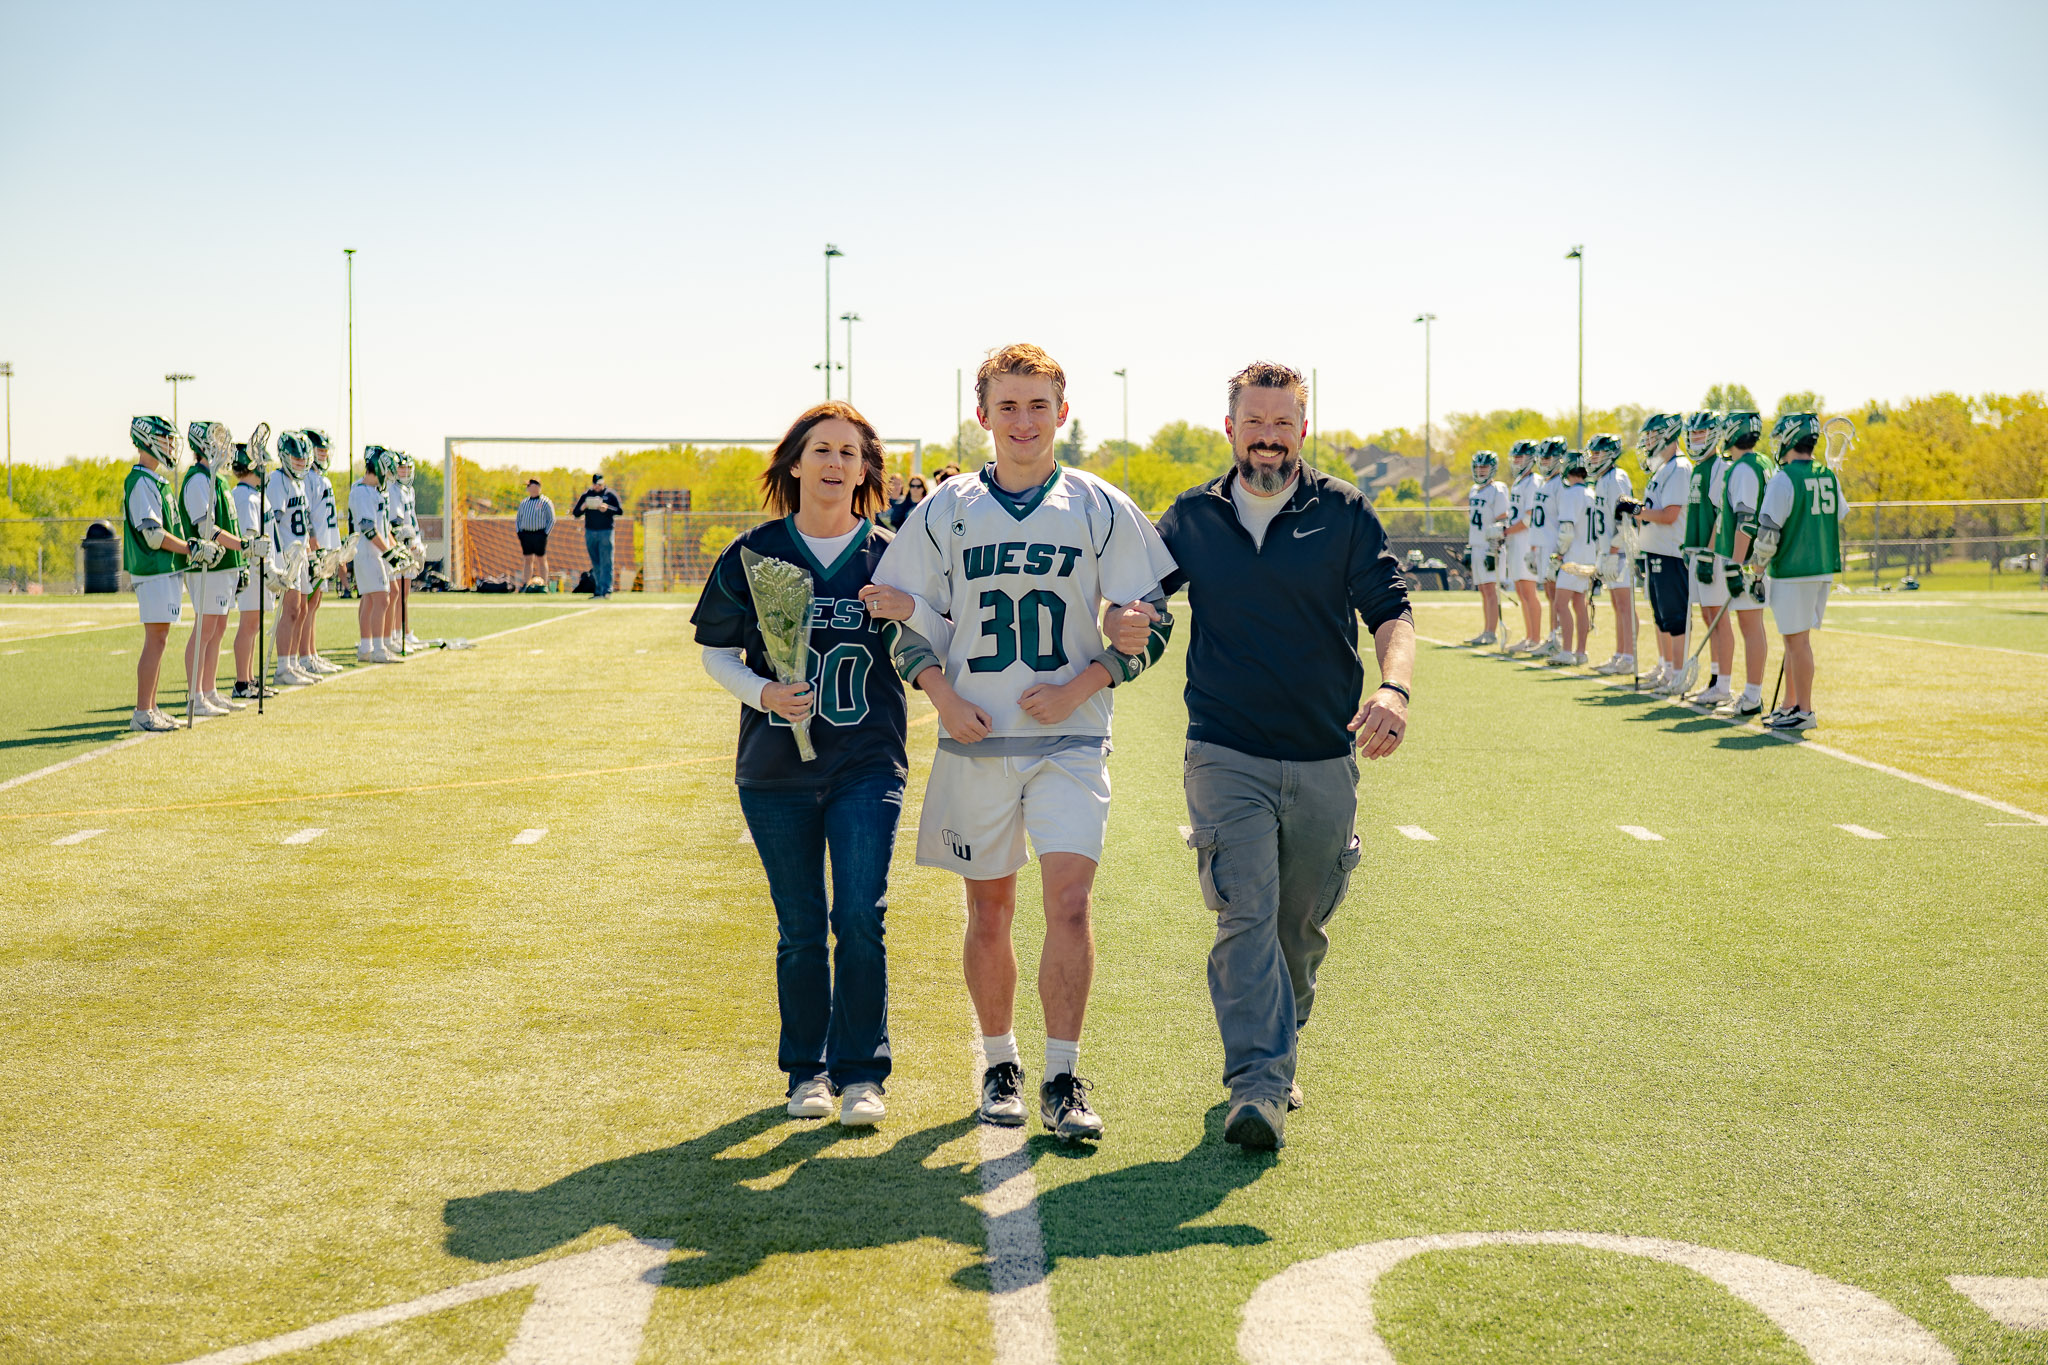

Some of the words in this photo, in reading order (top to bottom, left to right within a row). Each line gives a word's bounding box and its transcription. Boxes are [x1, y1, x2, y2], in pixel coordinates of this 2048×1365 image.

[1804, 476, 1836, 516] 75
[963, 541, 1083, 581] WEST
[967, 588, 1070, 674] 30
